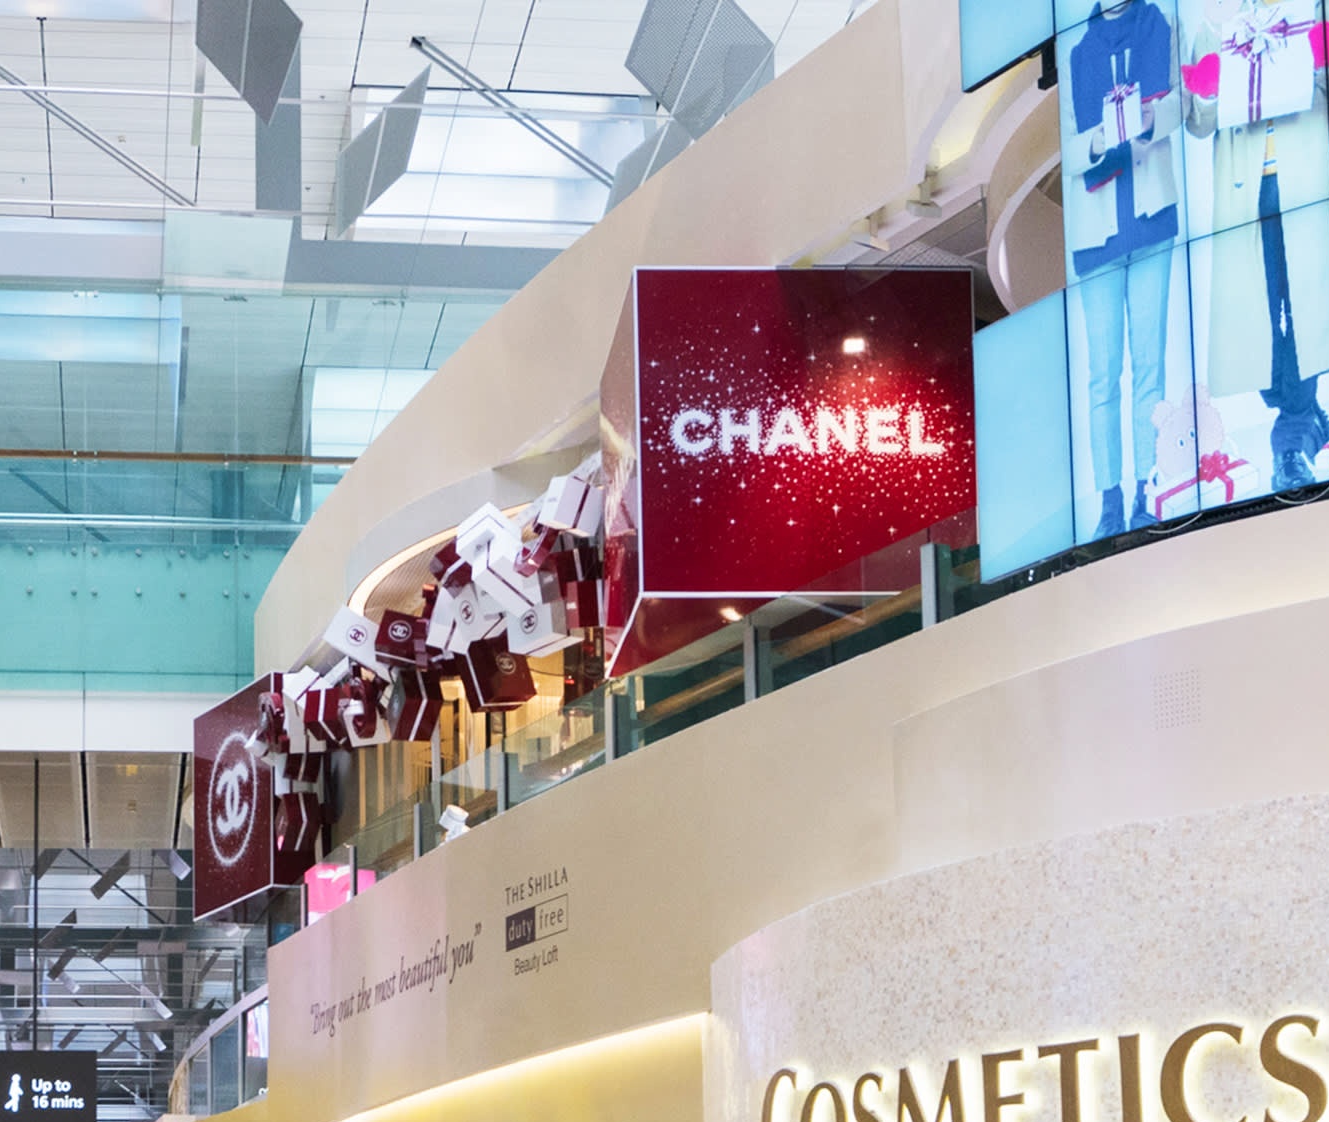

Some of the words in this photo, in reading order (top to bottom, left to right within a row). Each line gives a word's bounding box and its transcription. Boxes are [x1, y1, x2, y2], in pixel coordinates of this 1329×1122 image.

[671, 407, 947, 455] CHANEL
[504, 887, 525, 906] THE
[528, 867, 568, 898] SHILLA
[507, 915, 534, 941] duty
[538, 906, 565, 932] free
[514, 952, 541, 977] Beauty
[542, 945, 558, 967] Loft
[338, 995, 355, 1024] out
[357, 976, 372, 1015] the
[374, 972, 397, 1007] most
[399, 934, 449, 993] beautiful
[31, 1077, 53, 1096] Up
[54, 1078, 71, 1093] to
[31, 1095, 49, 1110] 16
[50, 1095, 85, 1110] mins
